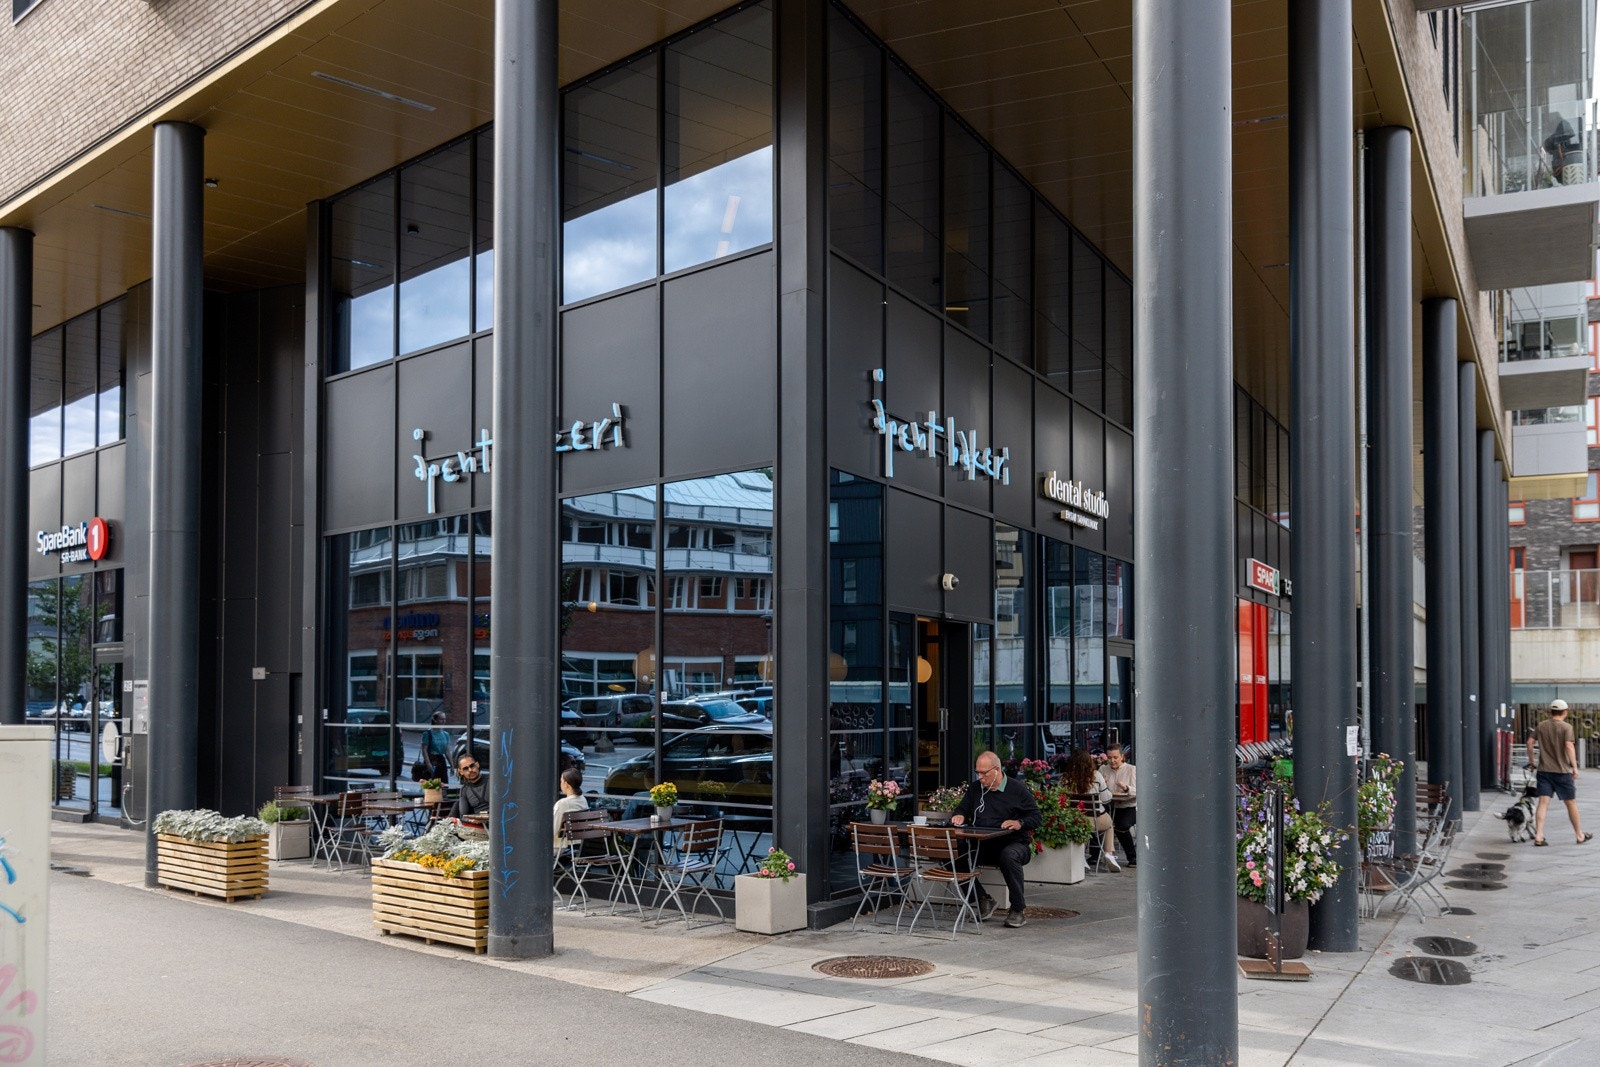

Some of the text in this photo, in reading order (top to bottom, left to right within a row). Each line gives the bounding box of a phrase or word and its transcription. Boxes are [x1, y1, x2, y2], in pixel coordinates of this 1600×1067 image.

[873, 368, 1009, 485] åpent bakeri
[1049, 470, 1109, 519] dental studio
[37, 521, 99, 556] SpareBank 1
[1256, 566, 1274, 588] SPAR
